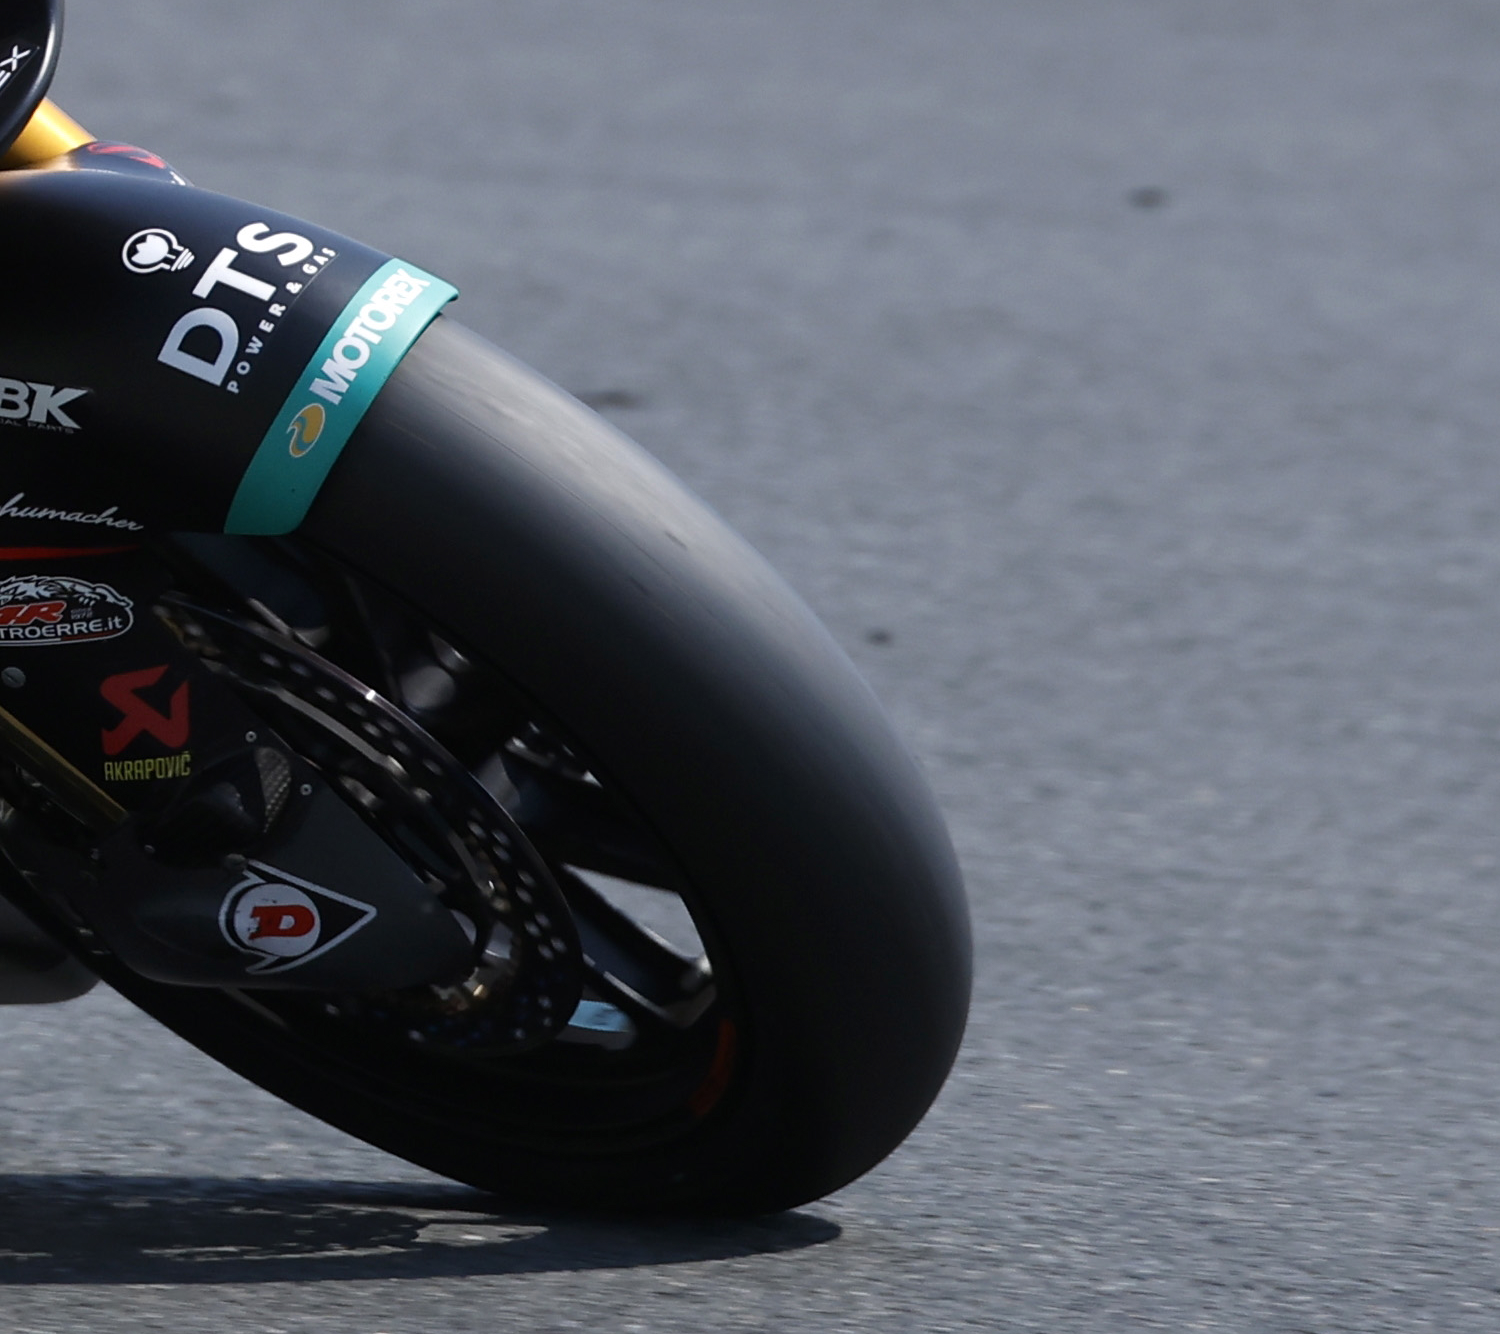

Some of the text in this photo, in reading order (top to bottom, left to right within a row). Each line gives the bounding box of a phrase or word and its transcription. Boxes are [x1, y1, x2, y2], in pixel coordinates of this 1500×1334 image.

[157, 222, 314, 387] DTS
[226, 247, 337, 395] POWER & GAS
[308, 267, 431, 406] MOTOREX
[103, 750, 193, 782] AKRAPOVIČ
